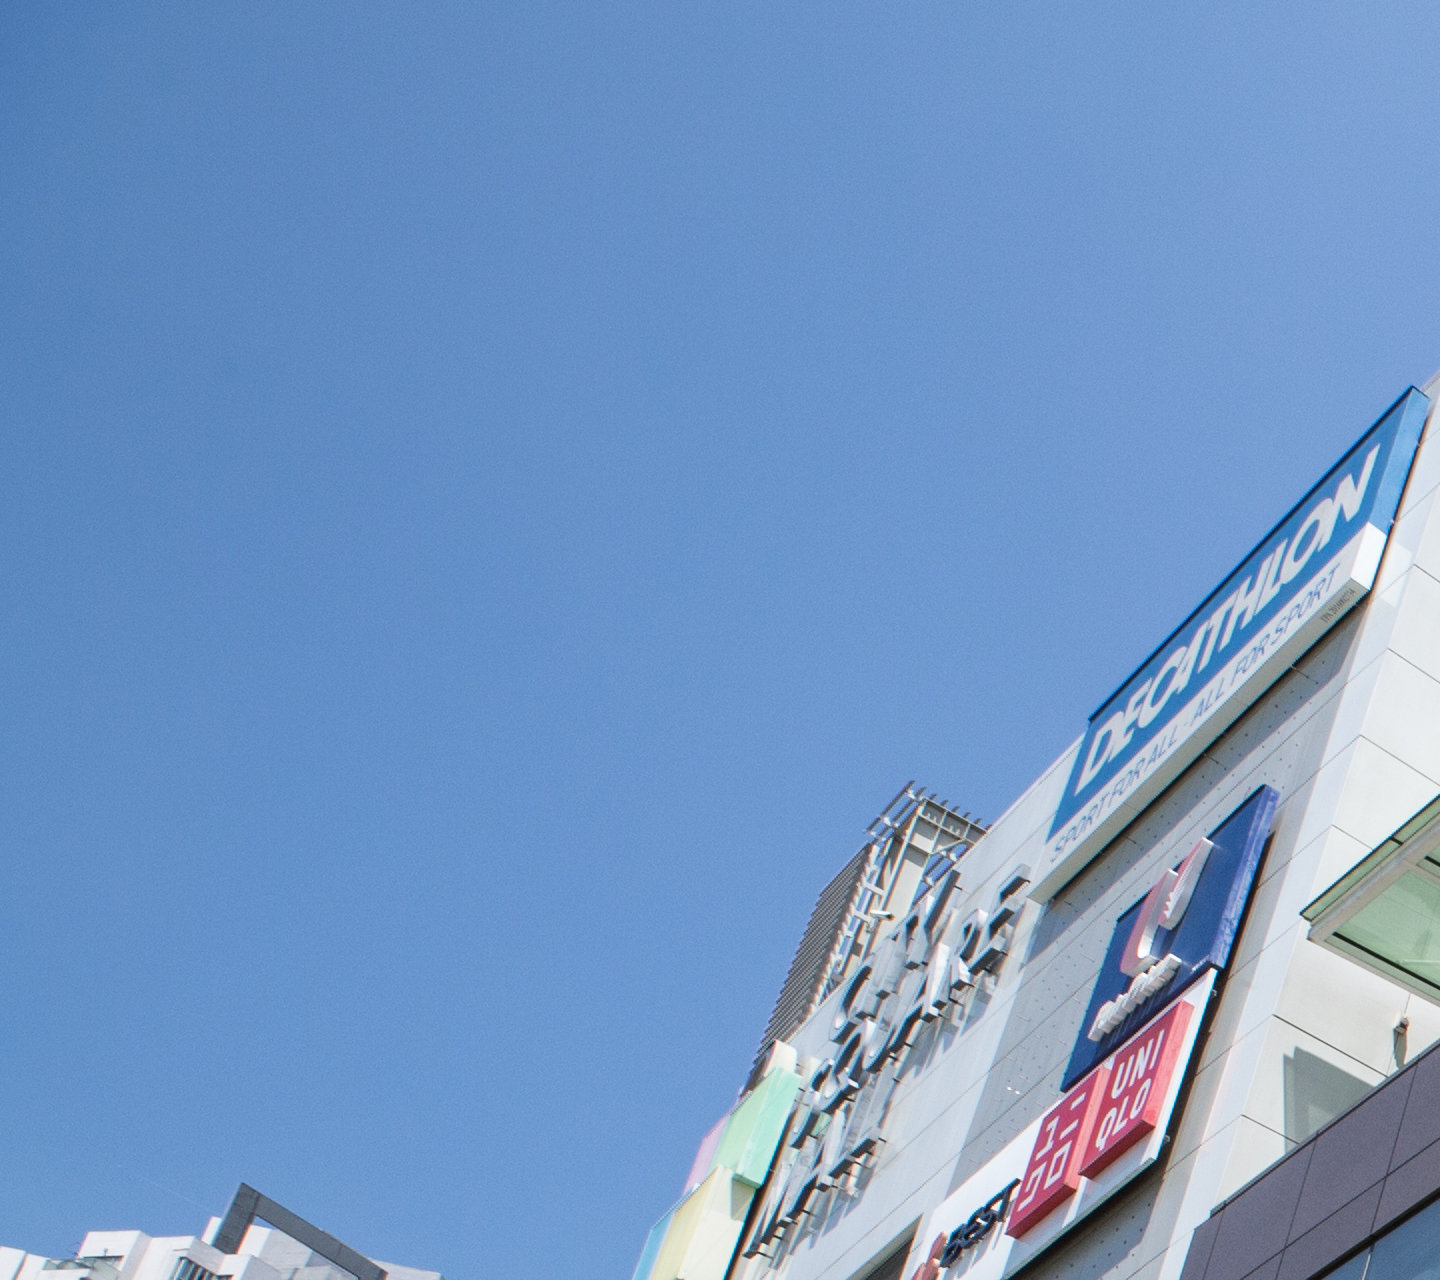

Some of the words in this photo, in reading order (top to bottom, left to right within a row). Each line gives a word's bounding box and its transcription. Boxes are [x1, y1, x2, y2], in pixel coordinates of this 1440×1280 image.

[1049, 790, 1106, 864] SPORT
[1107, 755, 1147, 810] FOR
[1145, 724, 1179, 769] ALL
[1190, 676, 1226, 729] ALL
[1234, 635, 1271, 683] FOR
[1271, 562, 1341, 645] SPORT
[1073, 443, 1381, 798] DECATHLON
[1094, 1077, 1152, 1152] QLO
[1100, 1028, 1166, 1101] UNI
